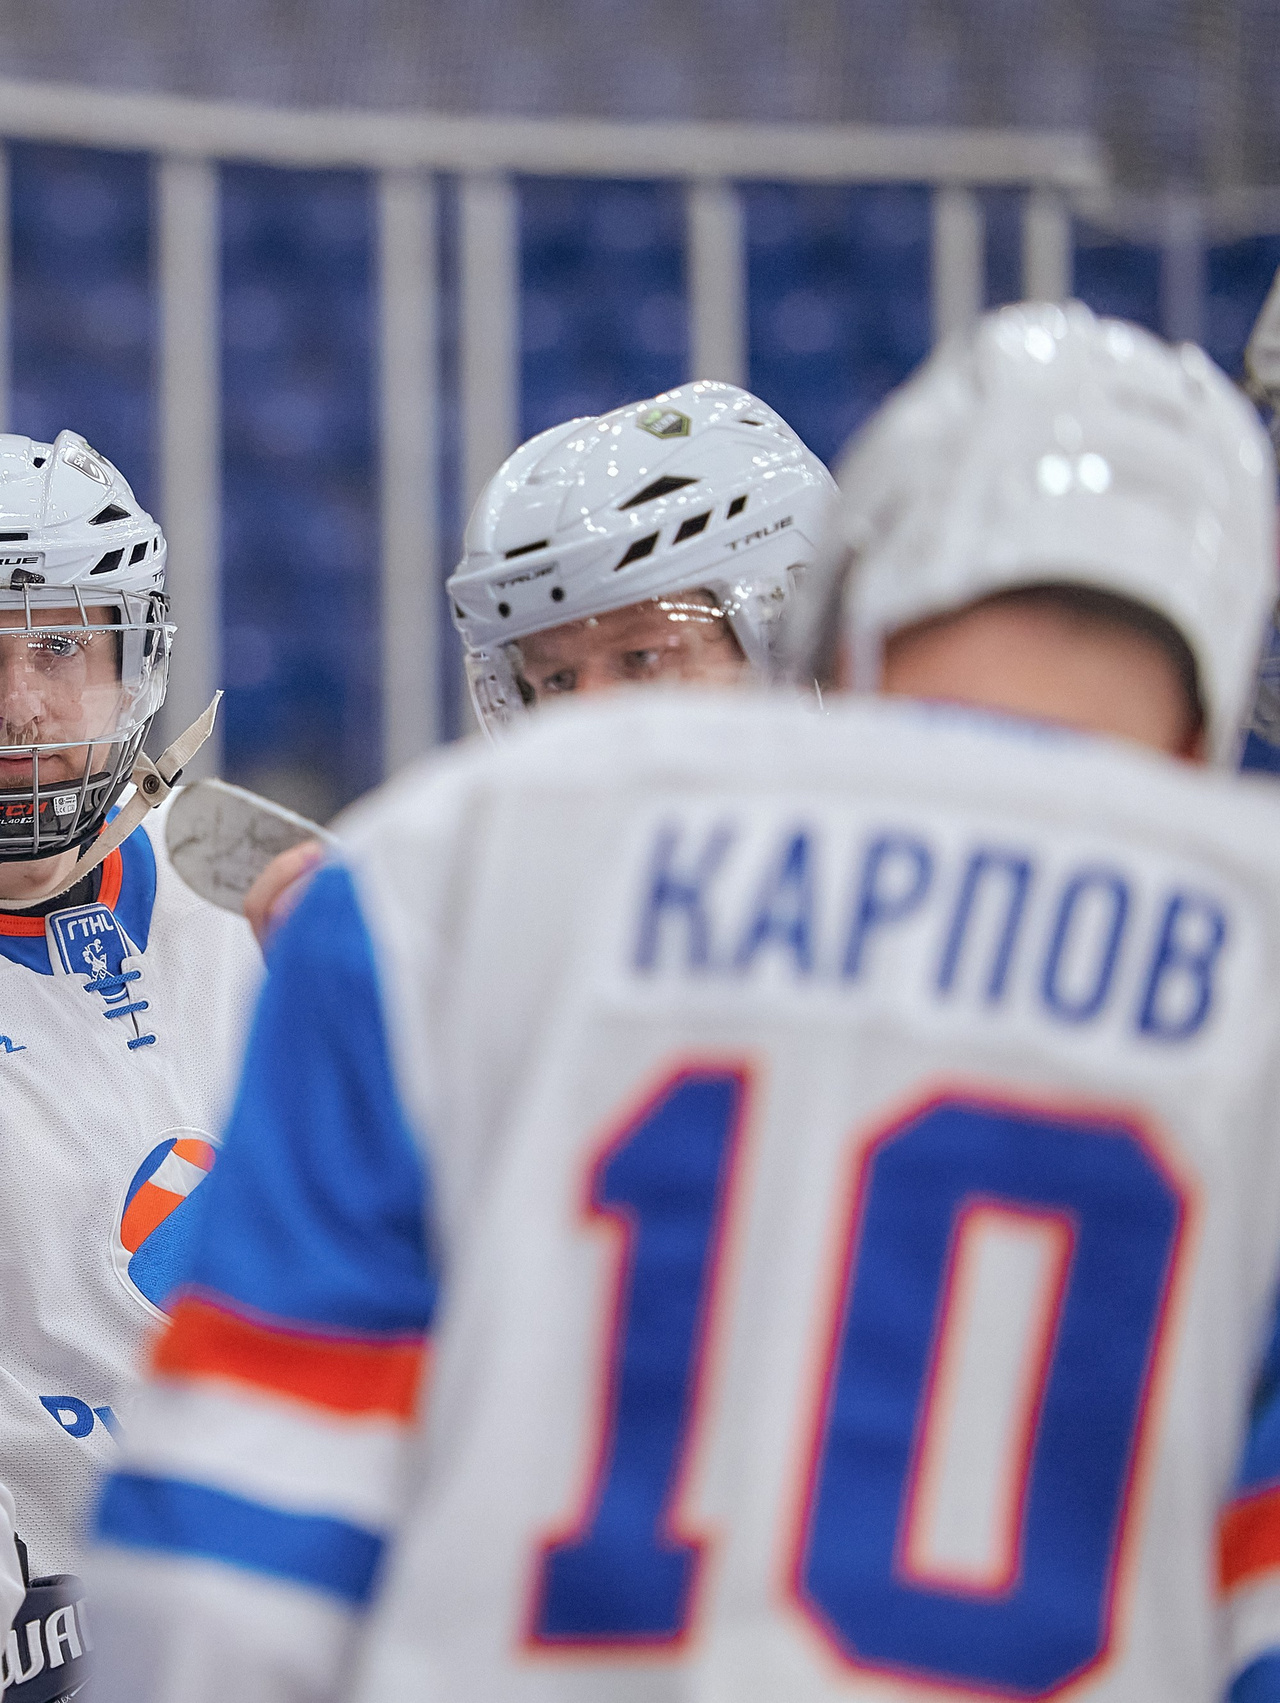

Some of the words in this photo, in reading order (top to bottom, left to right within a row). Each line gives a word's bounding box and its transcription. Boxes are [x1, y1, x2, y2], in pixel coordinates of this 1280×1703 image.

[724, 515, 795, 552] TRUE
[629, 815, 1232, 1047] КАРПОВ
[518, 1050, 1202, 1703] 10
